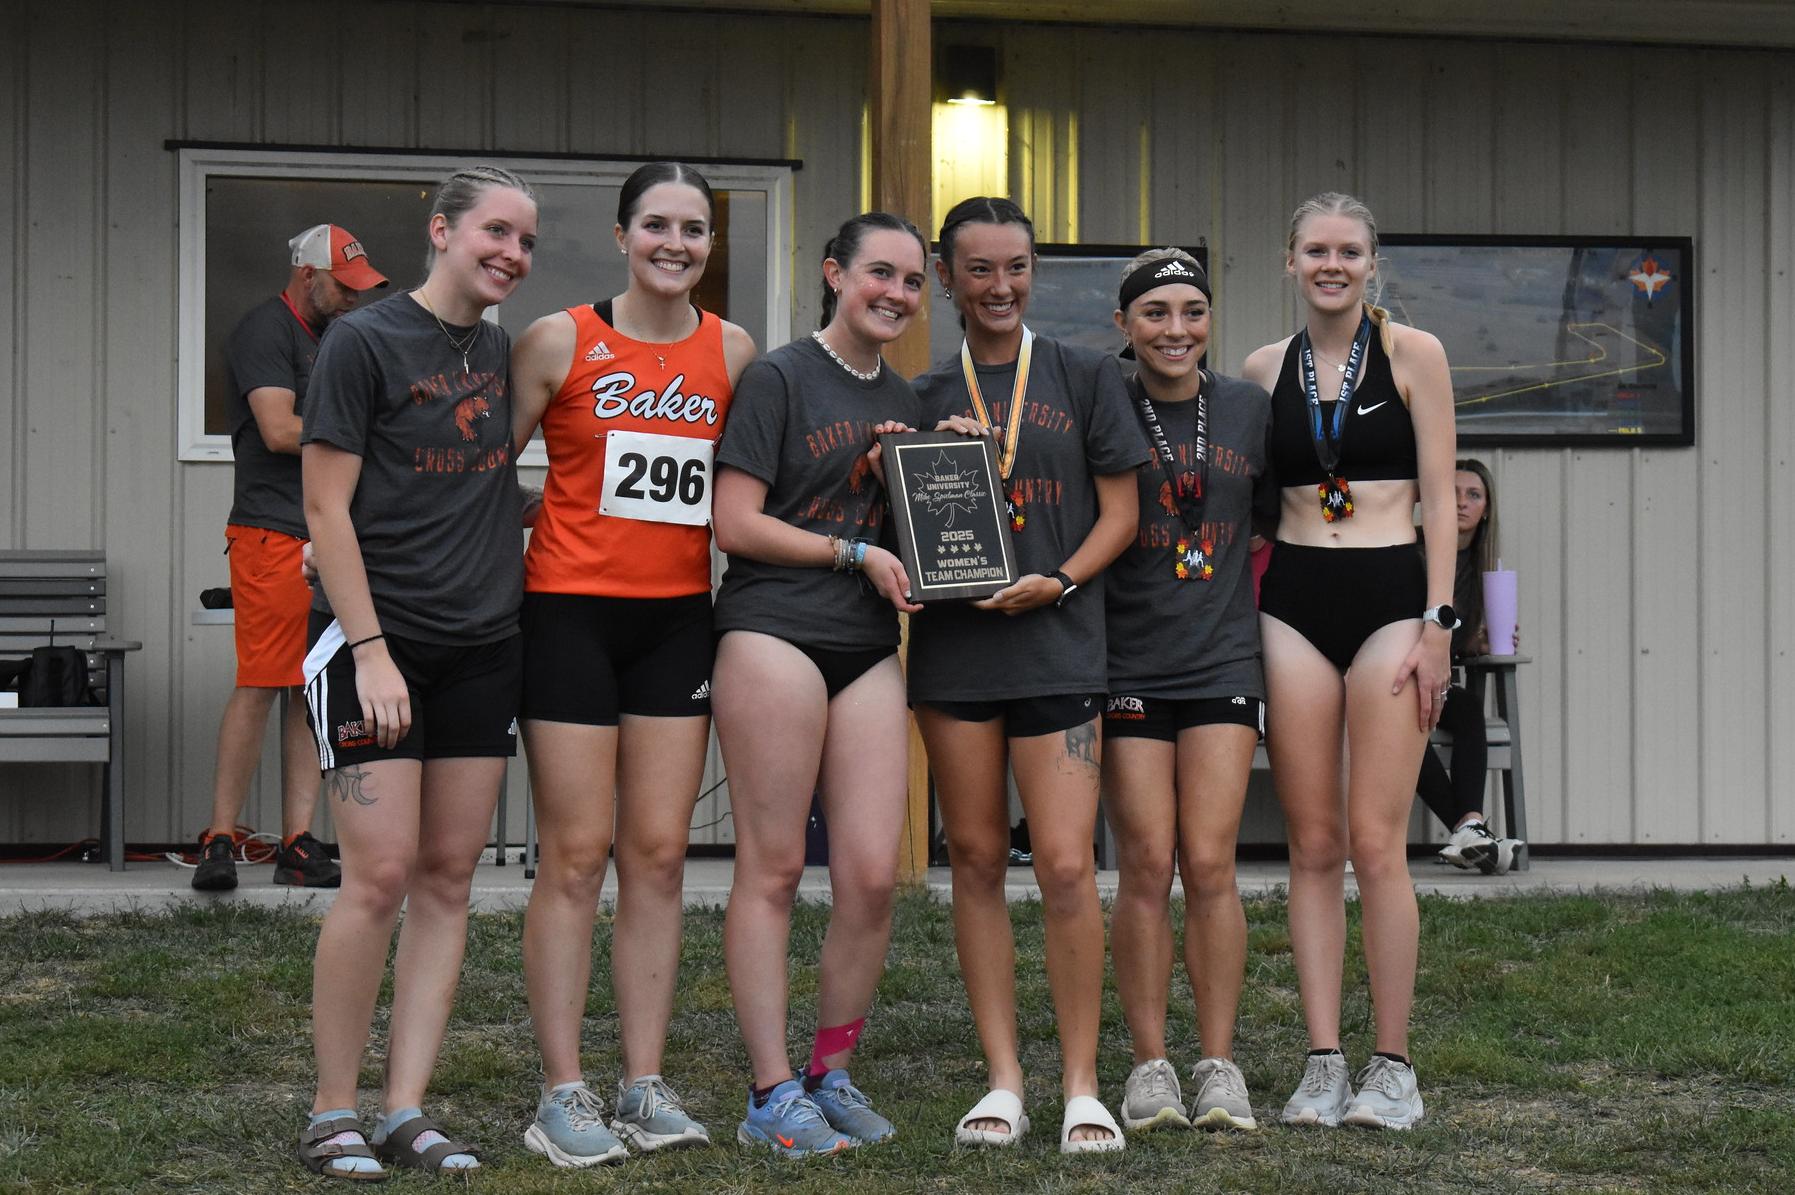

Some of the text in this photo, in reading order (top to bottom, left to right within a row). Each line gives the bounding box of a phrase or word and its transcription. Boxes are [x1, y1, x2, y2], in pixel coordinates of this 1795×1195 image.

[1154, 268, 1195, 279] adidas
[585, 352, 615, 362] adidas
[591, 370, 719, 426] Baker
[992, 400, 1074, 434] NIRSITY
[805, 420, 856, 459] BAKER
[1142, 398, 1158, 422] 2ND
[1151, 424, 1175, 462] PLACE
[1196, 394, 1208, 464] 2ND PLACE
[614, 452, 706, 506] 296
[926, 481, 971, 491] UNIVERSITY
[934, 474, 960, 483] BAKER
[1014, 478, 1063, 506] UNTRY
[940, 529, 975, 542] 2025
[1139, 523, 1171, 548] OSS
[936, 555, 988, 569] WOMEN'S
[924, 566, 1004, 582] TEAM CHAMPION
[1106, 696, 1145, 713] BAKER
[337, 719, 366, 742] BAK
